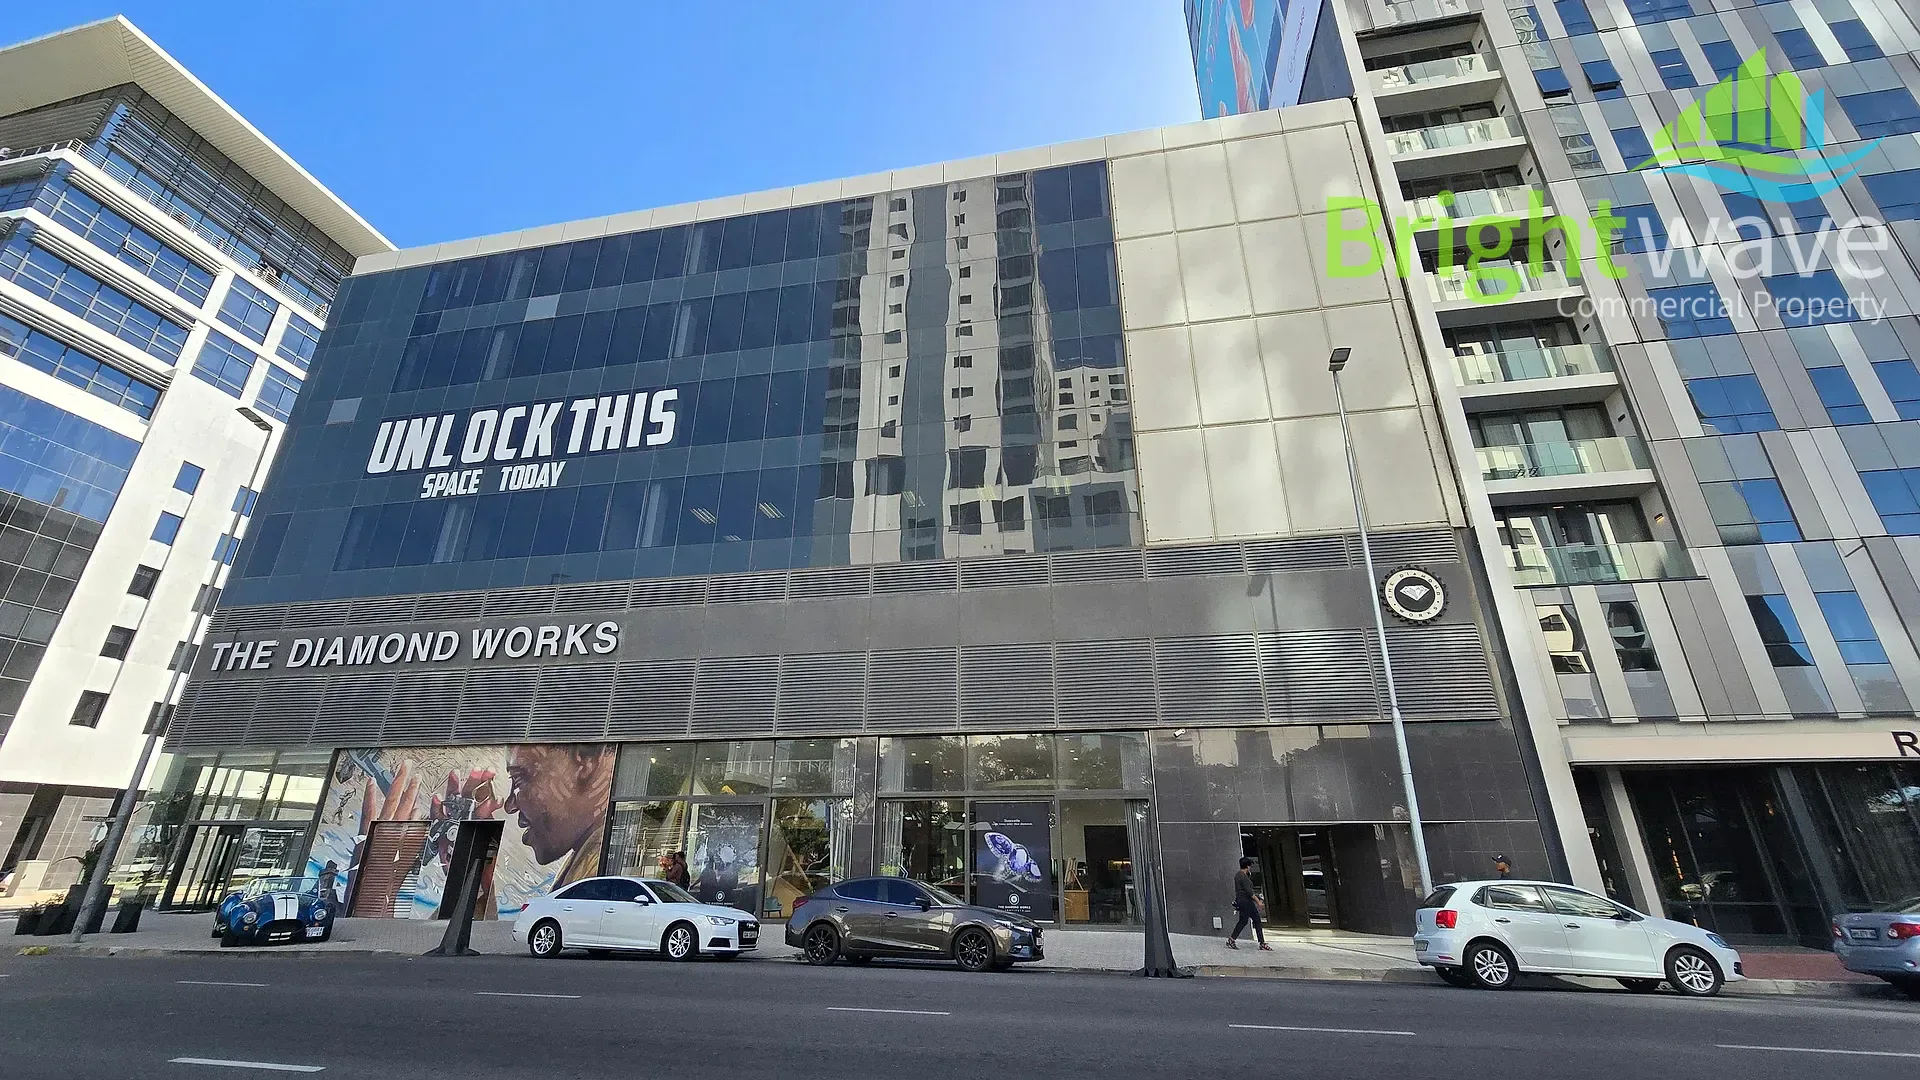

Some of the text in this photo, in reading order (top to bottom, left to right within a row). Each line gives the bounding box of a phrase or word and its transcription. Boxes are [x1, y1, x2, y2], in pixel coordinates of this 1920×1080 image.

[366, 388, 679, 474] UNLOCK THIS
[420, 461, 567, 499] SPACE TODAY
[1387, 572, 1441, 618] THE DIAMOND WORKS
[210, 621, 620, 672] THE DIAMOND WORKS
